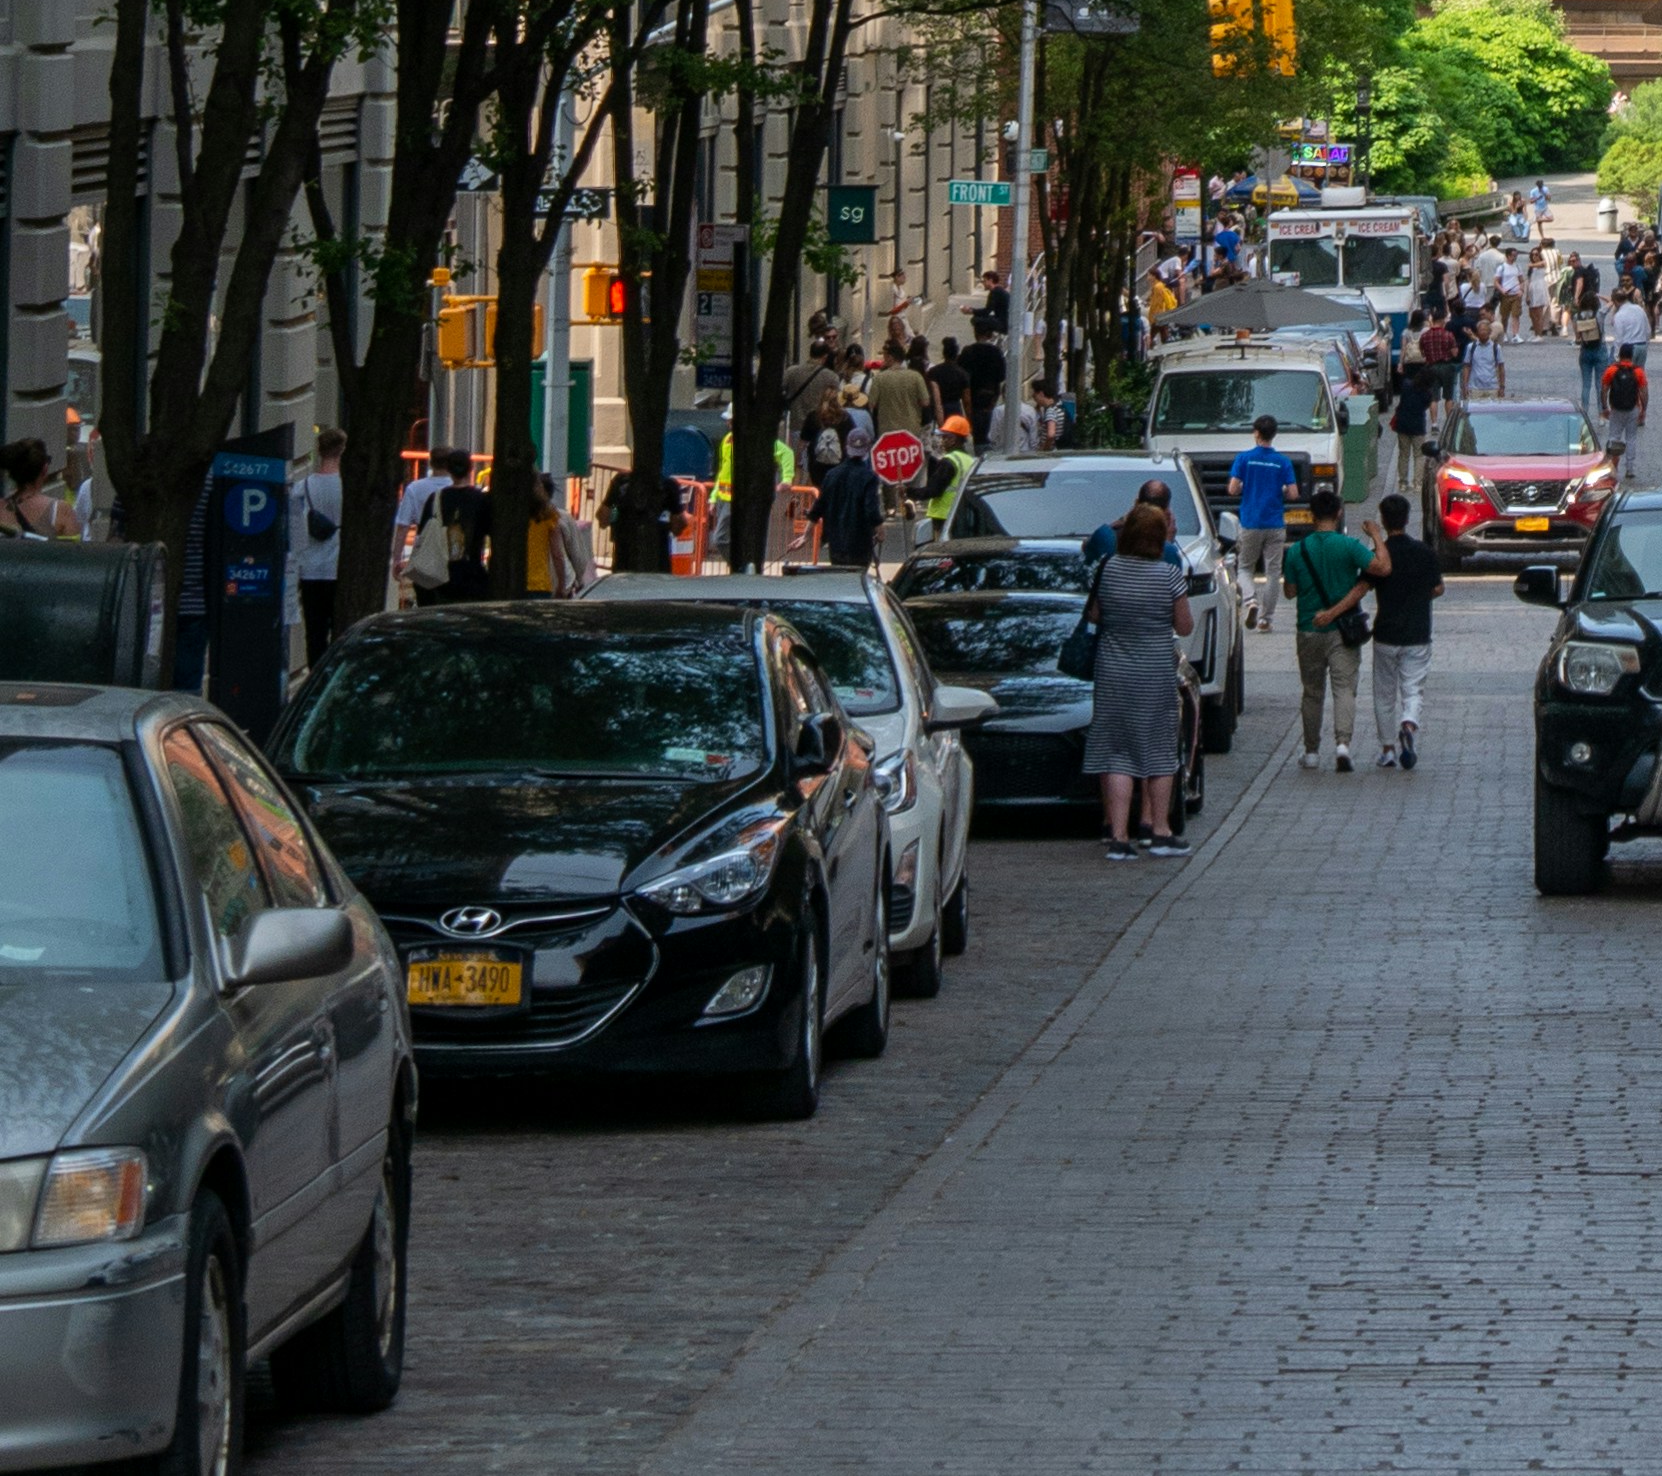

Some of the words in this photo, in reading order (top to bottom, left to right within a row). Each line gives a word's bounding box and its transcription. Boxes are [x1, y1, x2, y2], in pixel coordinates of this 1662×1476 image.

[952, 184, 994, 202] FRONT
[1000, 185, 1009, 195] ST
[839, 205, 865, 223] sg
[1279, 224, 1292, 236] ICE
[1357, 222, 1371, 234] ICE
[1373, 221, 1400, 233] CREAM
[876, 445, 920, 468] STOP
[242, 488, 268, 528] P
[229, 568, 270, 581] 342677
